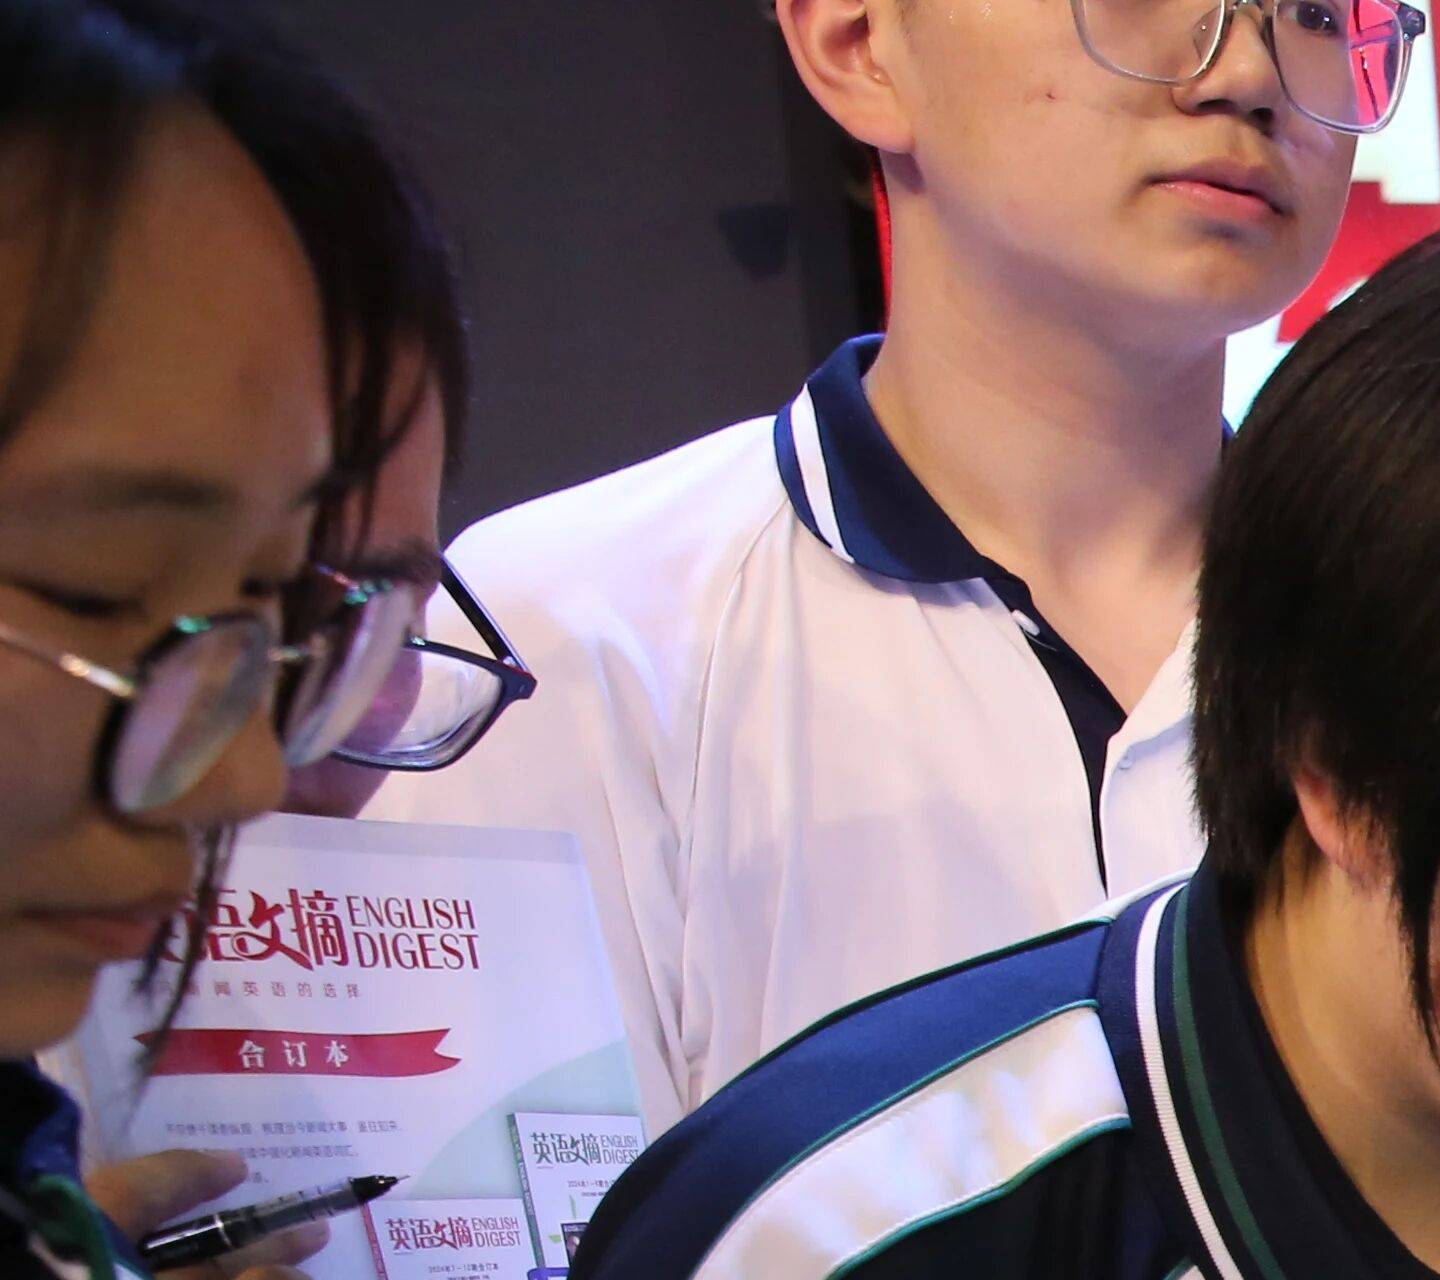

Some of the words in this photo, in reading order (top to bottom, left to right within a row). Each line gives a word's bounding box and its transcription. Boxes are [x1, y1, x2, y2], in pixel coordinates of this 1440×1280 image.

[346, 895, 476, 930] ENGLISH
[354, 932, 480, 970] DIGEST
[238, 1040, 350, 1069] 合订本
[531, 1132, 601, 1166] 英语文摘
[600, 1134, 638, 1148] ENGLISH
[385, 1217, 474, 1251] 英语文摘
[473, 1217, 518, 1231] ENGLISH
[475, 1231, 521, 1248] DIGEST
